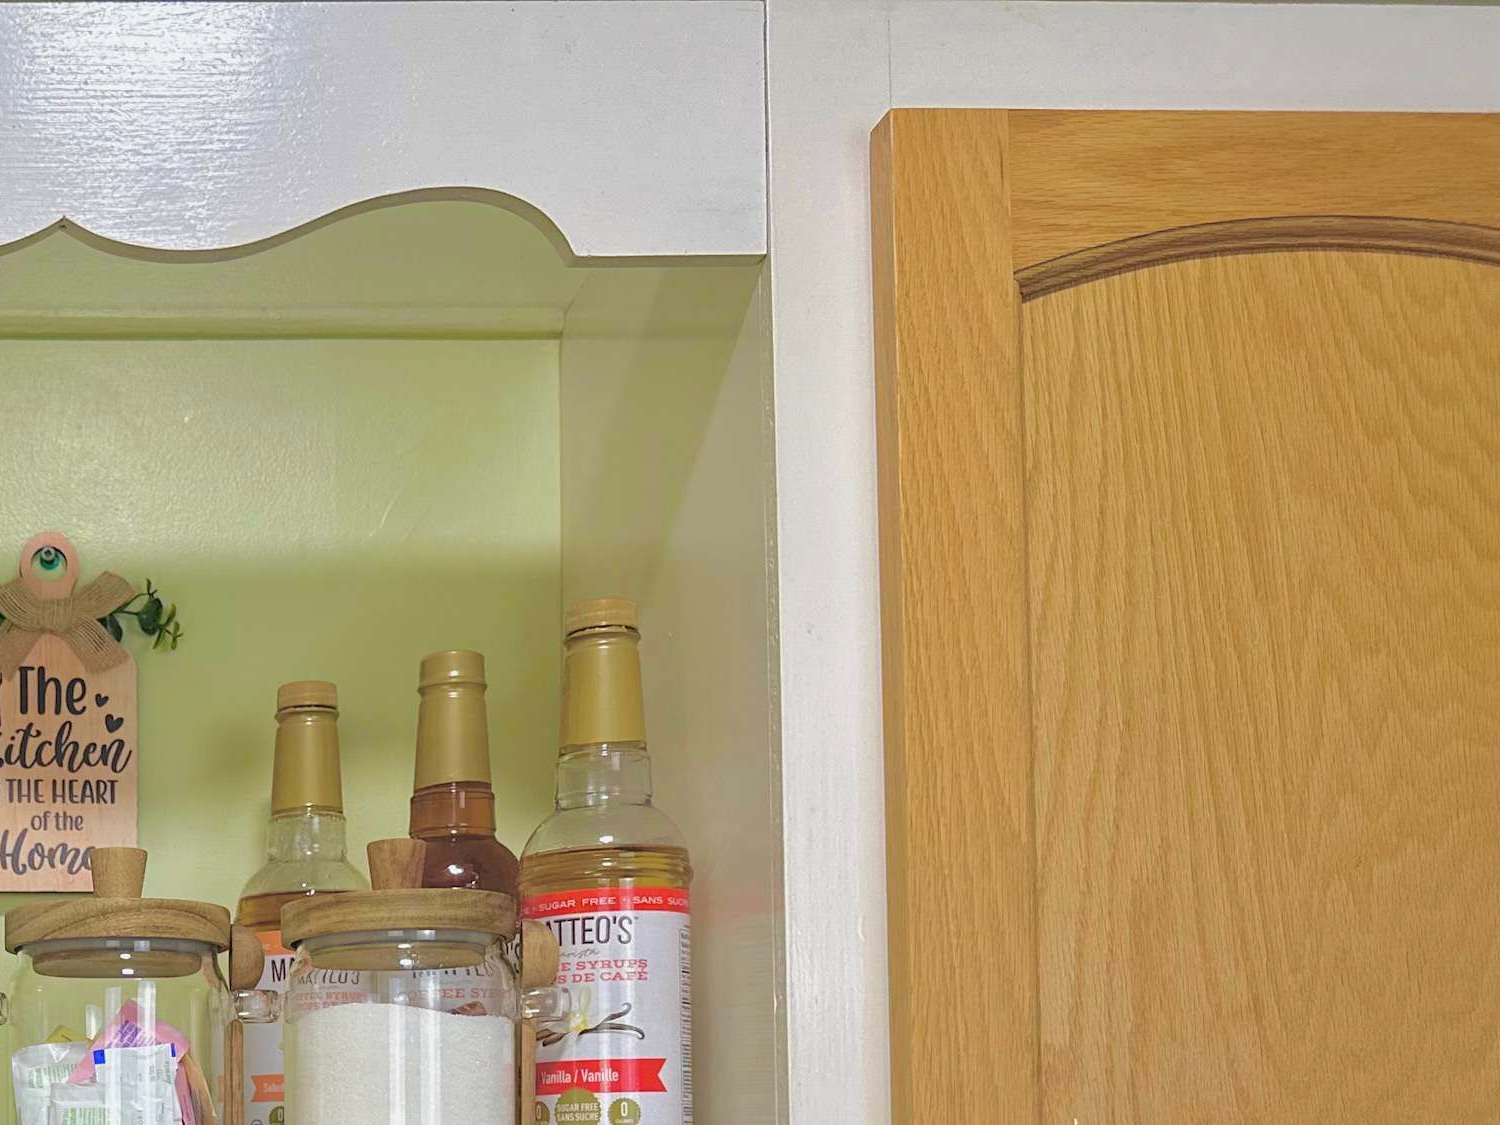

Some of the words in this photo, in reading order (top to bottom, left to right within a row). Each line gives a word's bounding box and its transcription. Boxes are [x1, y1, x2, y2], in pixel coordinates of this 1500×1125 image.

[19, 666, 86, 715] The
[5, 778, 44, 804] THE
[52, 779, 118, 805] HEART
[30, 811, 50, 831] of
[53, 811, 84, 831] the
[538, 899, 576, 912] SUGAR
[582, 896, 616, 906] FREE
[632, 896, 663, 905] SANS
[576, 959, 648, 970] SYRUPS
[572, 973, 595, 983] DE
[541, 1070, 572, 1085] Vanilla
[580, 1068, 619, 1082] Vanille
[581, 1103, 599, 1111] FREE
[620, 1101, 628, 1117] 0
